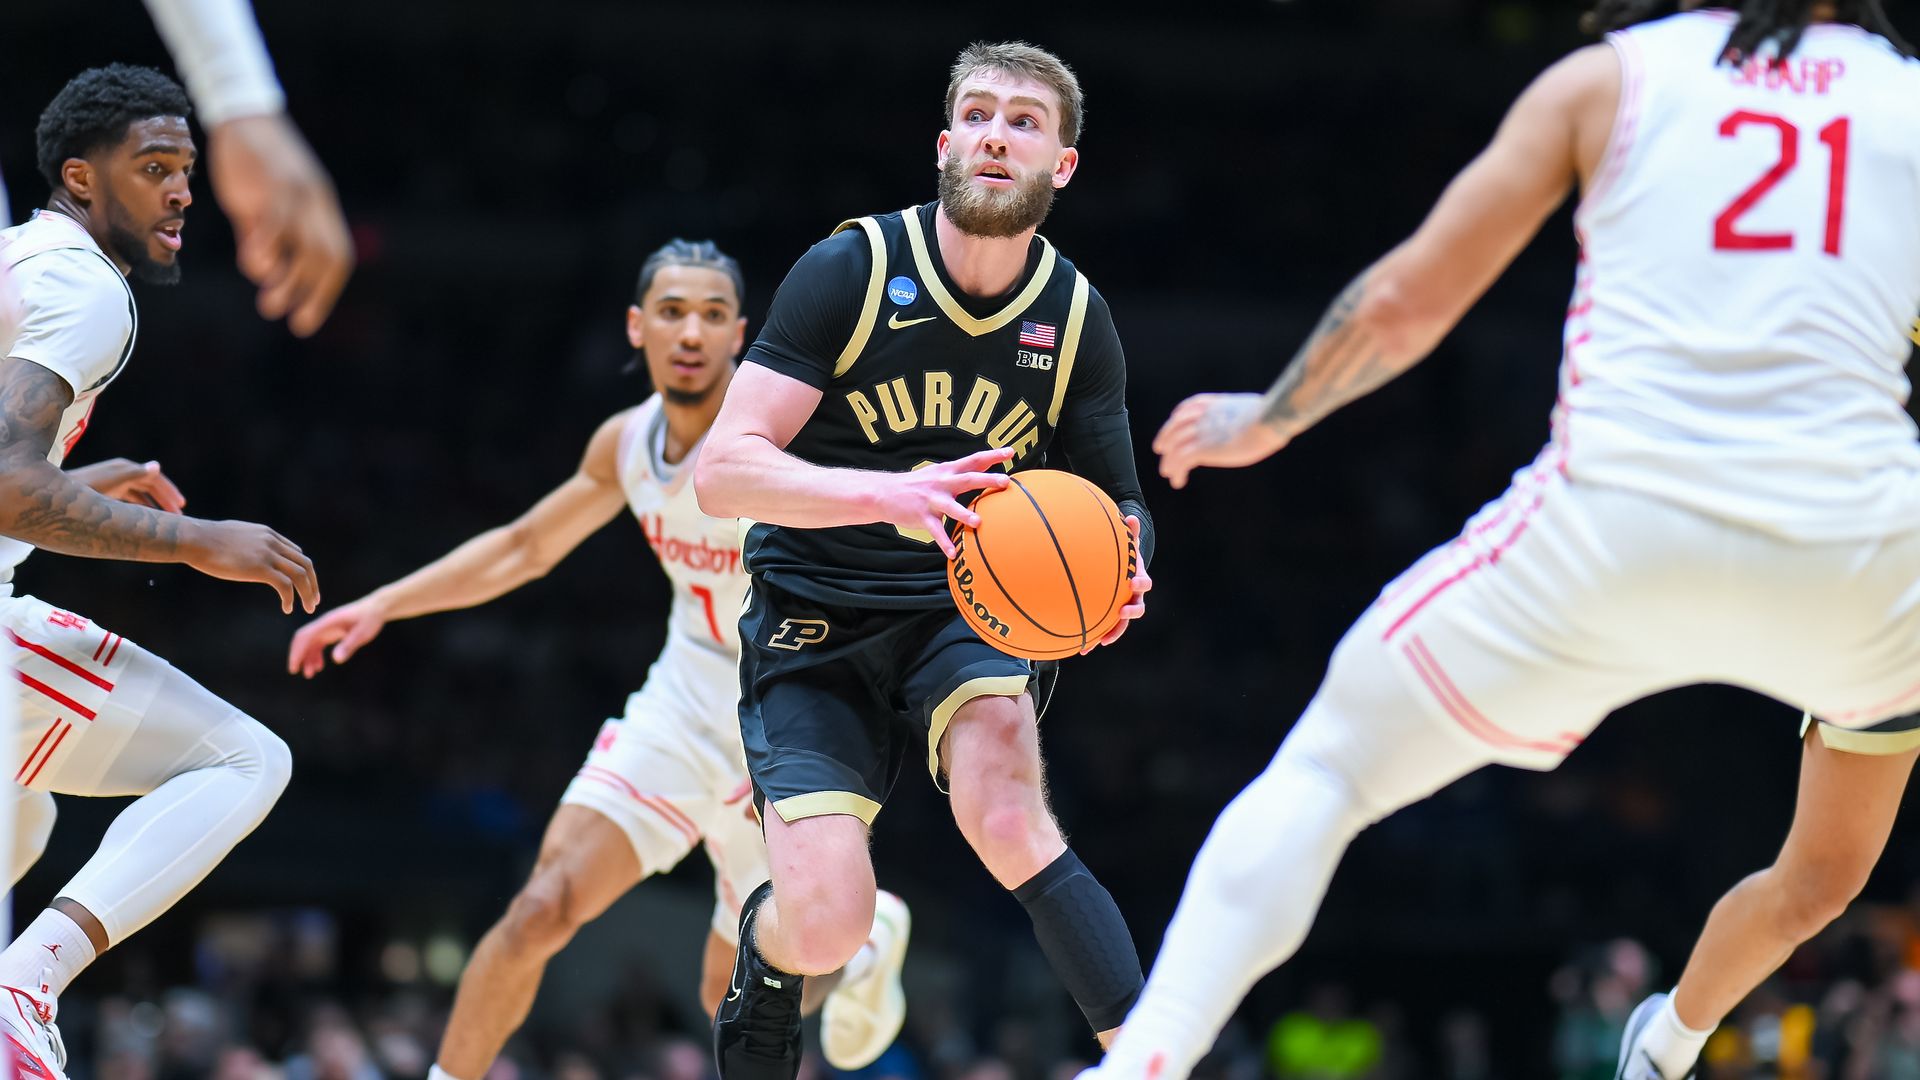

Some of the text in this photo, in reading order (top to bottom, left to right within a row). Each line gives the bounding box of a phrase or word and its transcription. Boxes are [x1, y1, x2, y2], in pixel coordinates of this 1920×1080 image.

[1713, 110, 1850, 258] 21
[890, 288, 915, 300] NCAA
[846, 370, 1039, 473] PURDUE
[689, 583, 725, 646] 7
[768, 618, 830, 651] P
